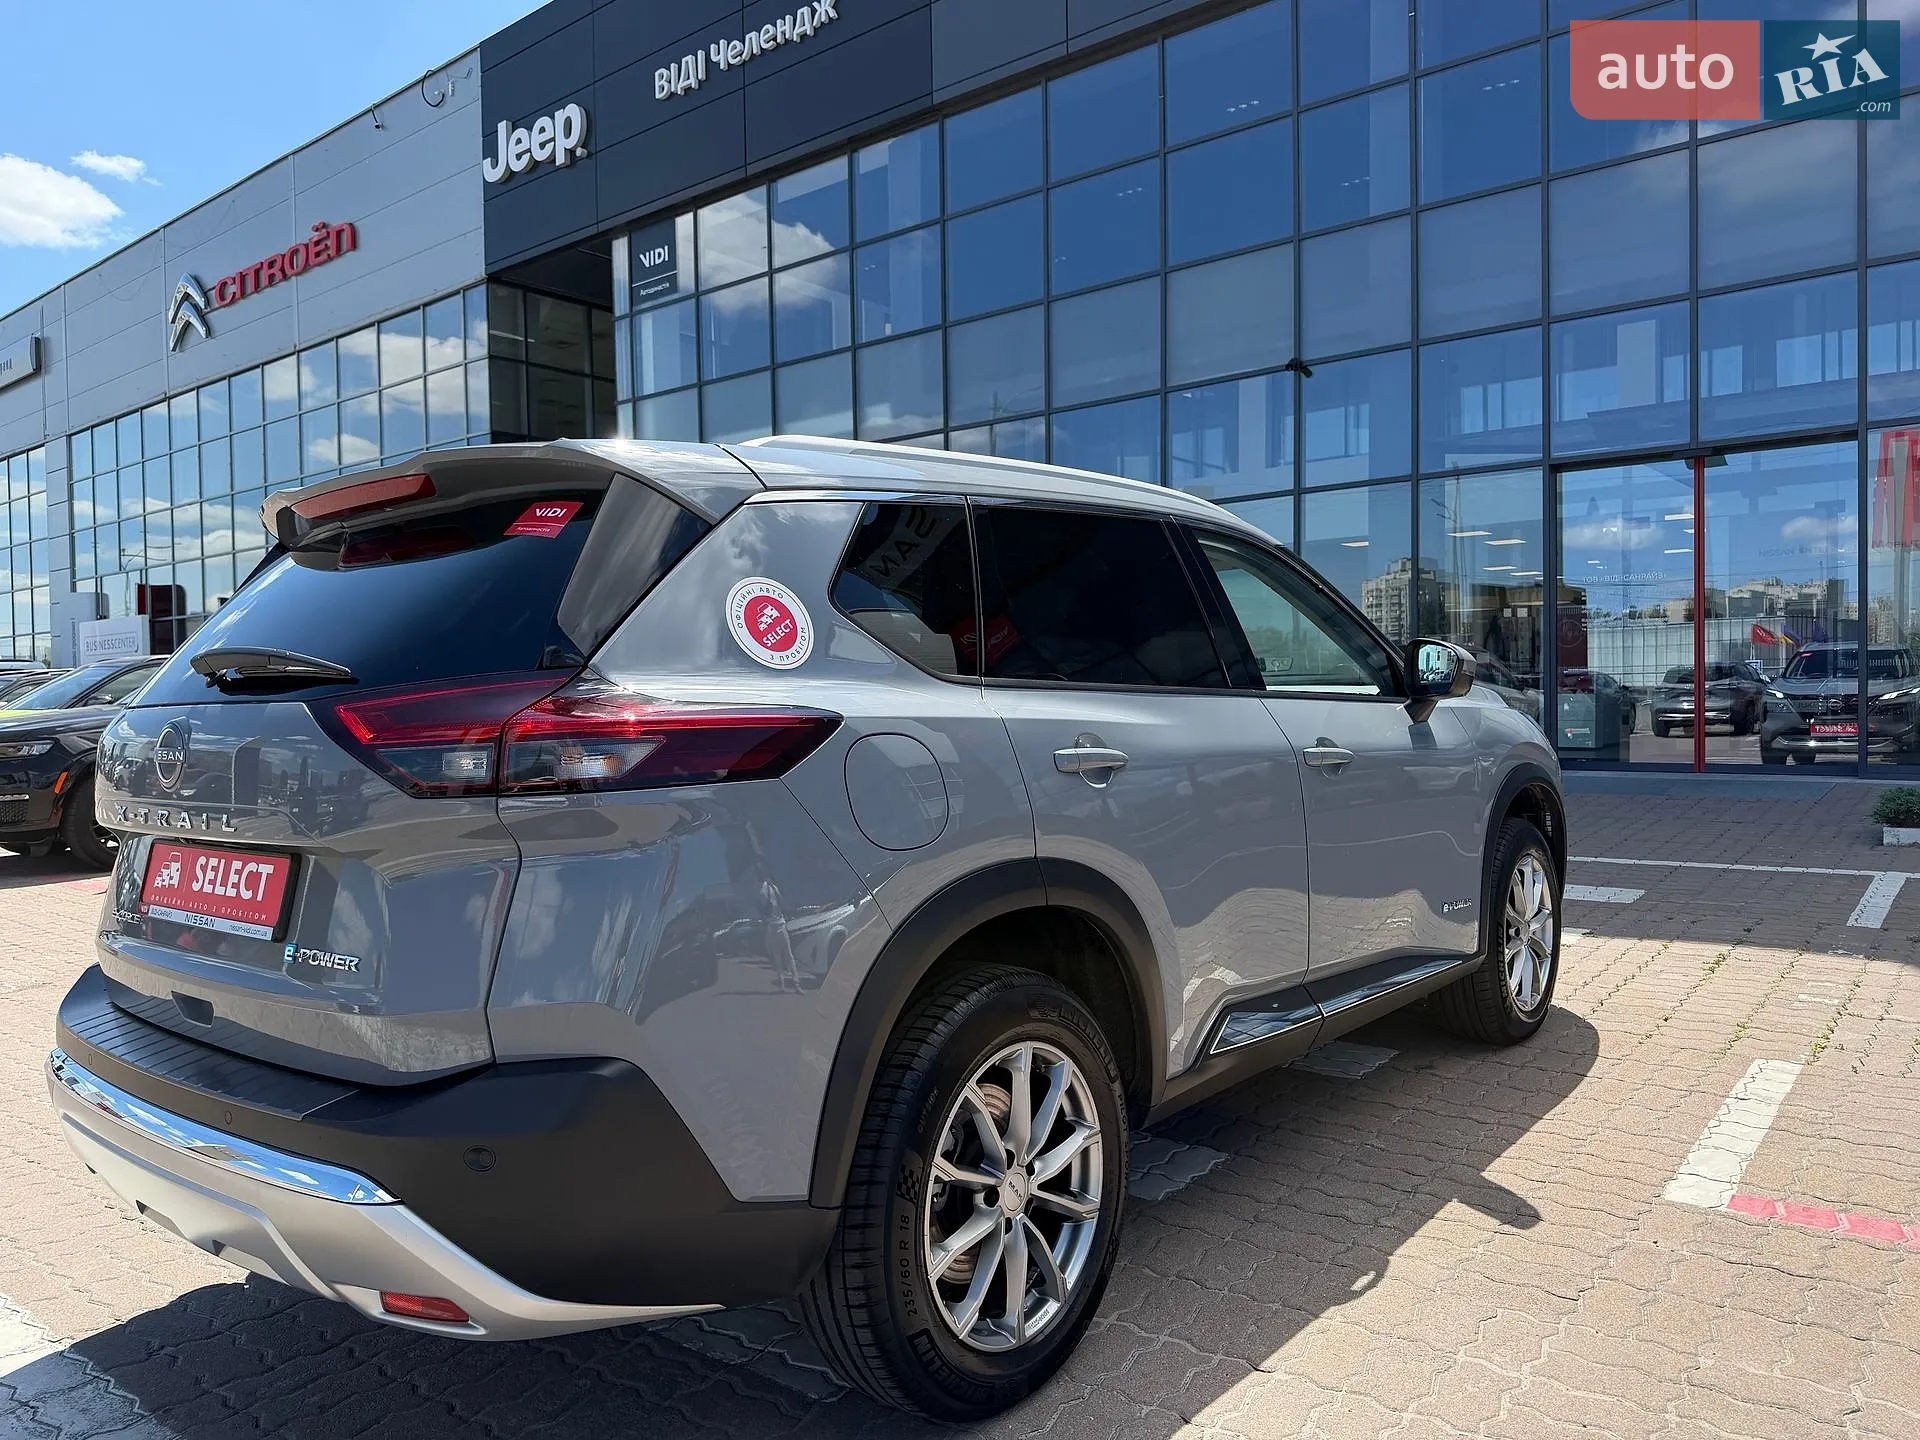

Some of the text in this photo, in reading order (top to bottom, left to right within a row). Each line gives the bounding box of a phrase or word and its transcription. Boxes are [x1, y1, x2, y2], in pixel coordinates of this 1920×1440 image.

[654, 0, 839, 100] ВІДІ Челендж
[482, 103, 588, 184] Jeep
[640, 245, 669, 268] VIDI
[535, 507, 568, 518] VIDI
[759, 586, 784, 600] АВТО
[762, 618, 794, 648] SELECT
[779, 627, 806, 662] ПРОБІГОМ
[157, 750, 184, 761] SSAN
[115, 801, 238, 833] X-TRAIL
[191, 855, 275, 902] SELECT
[184, 913, 217, 929] NISSAN
[284, 945, 361, 973] e-POWER
[1117, 1092, 1129, 1132] PILOT
[899, 1214, 918, 1317] 235/60 R 18
